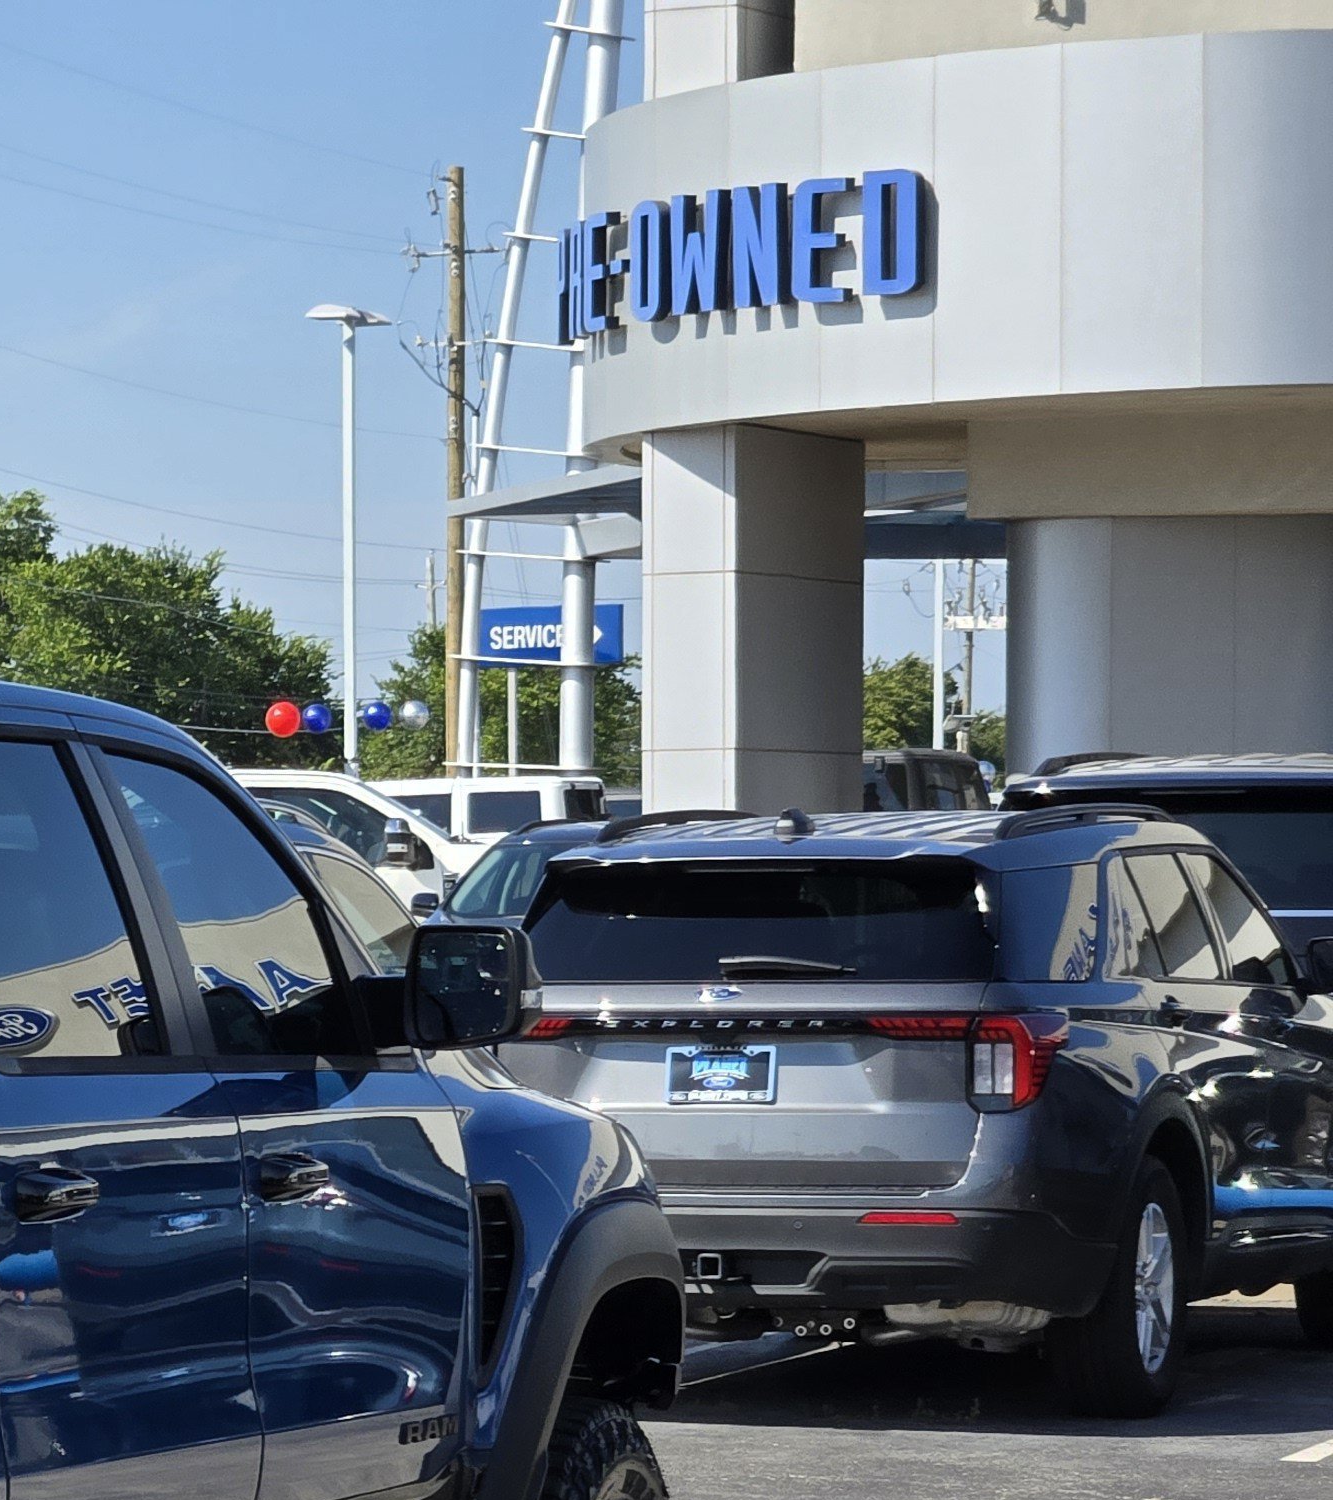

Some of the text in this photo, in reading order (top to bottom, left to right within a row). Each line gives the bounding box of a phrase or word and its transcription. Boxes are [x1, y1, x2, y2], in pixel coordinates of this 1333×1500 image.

[557, 168, 927, 346] PRE-OWNED
[489, 624, 564, 650] SERVICE
[603, 1019, 825, 1029] EXPLORER
